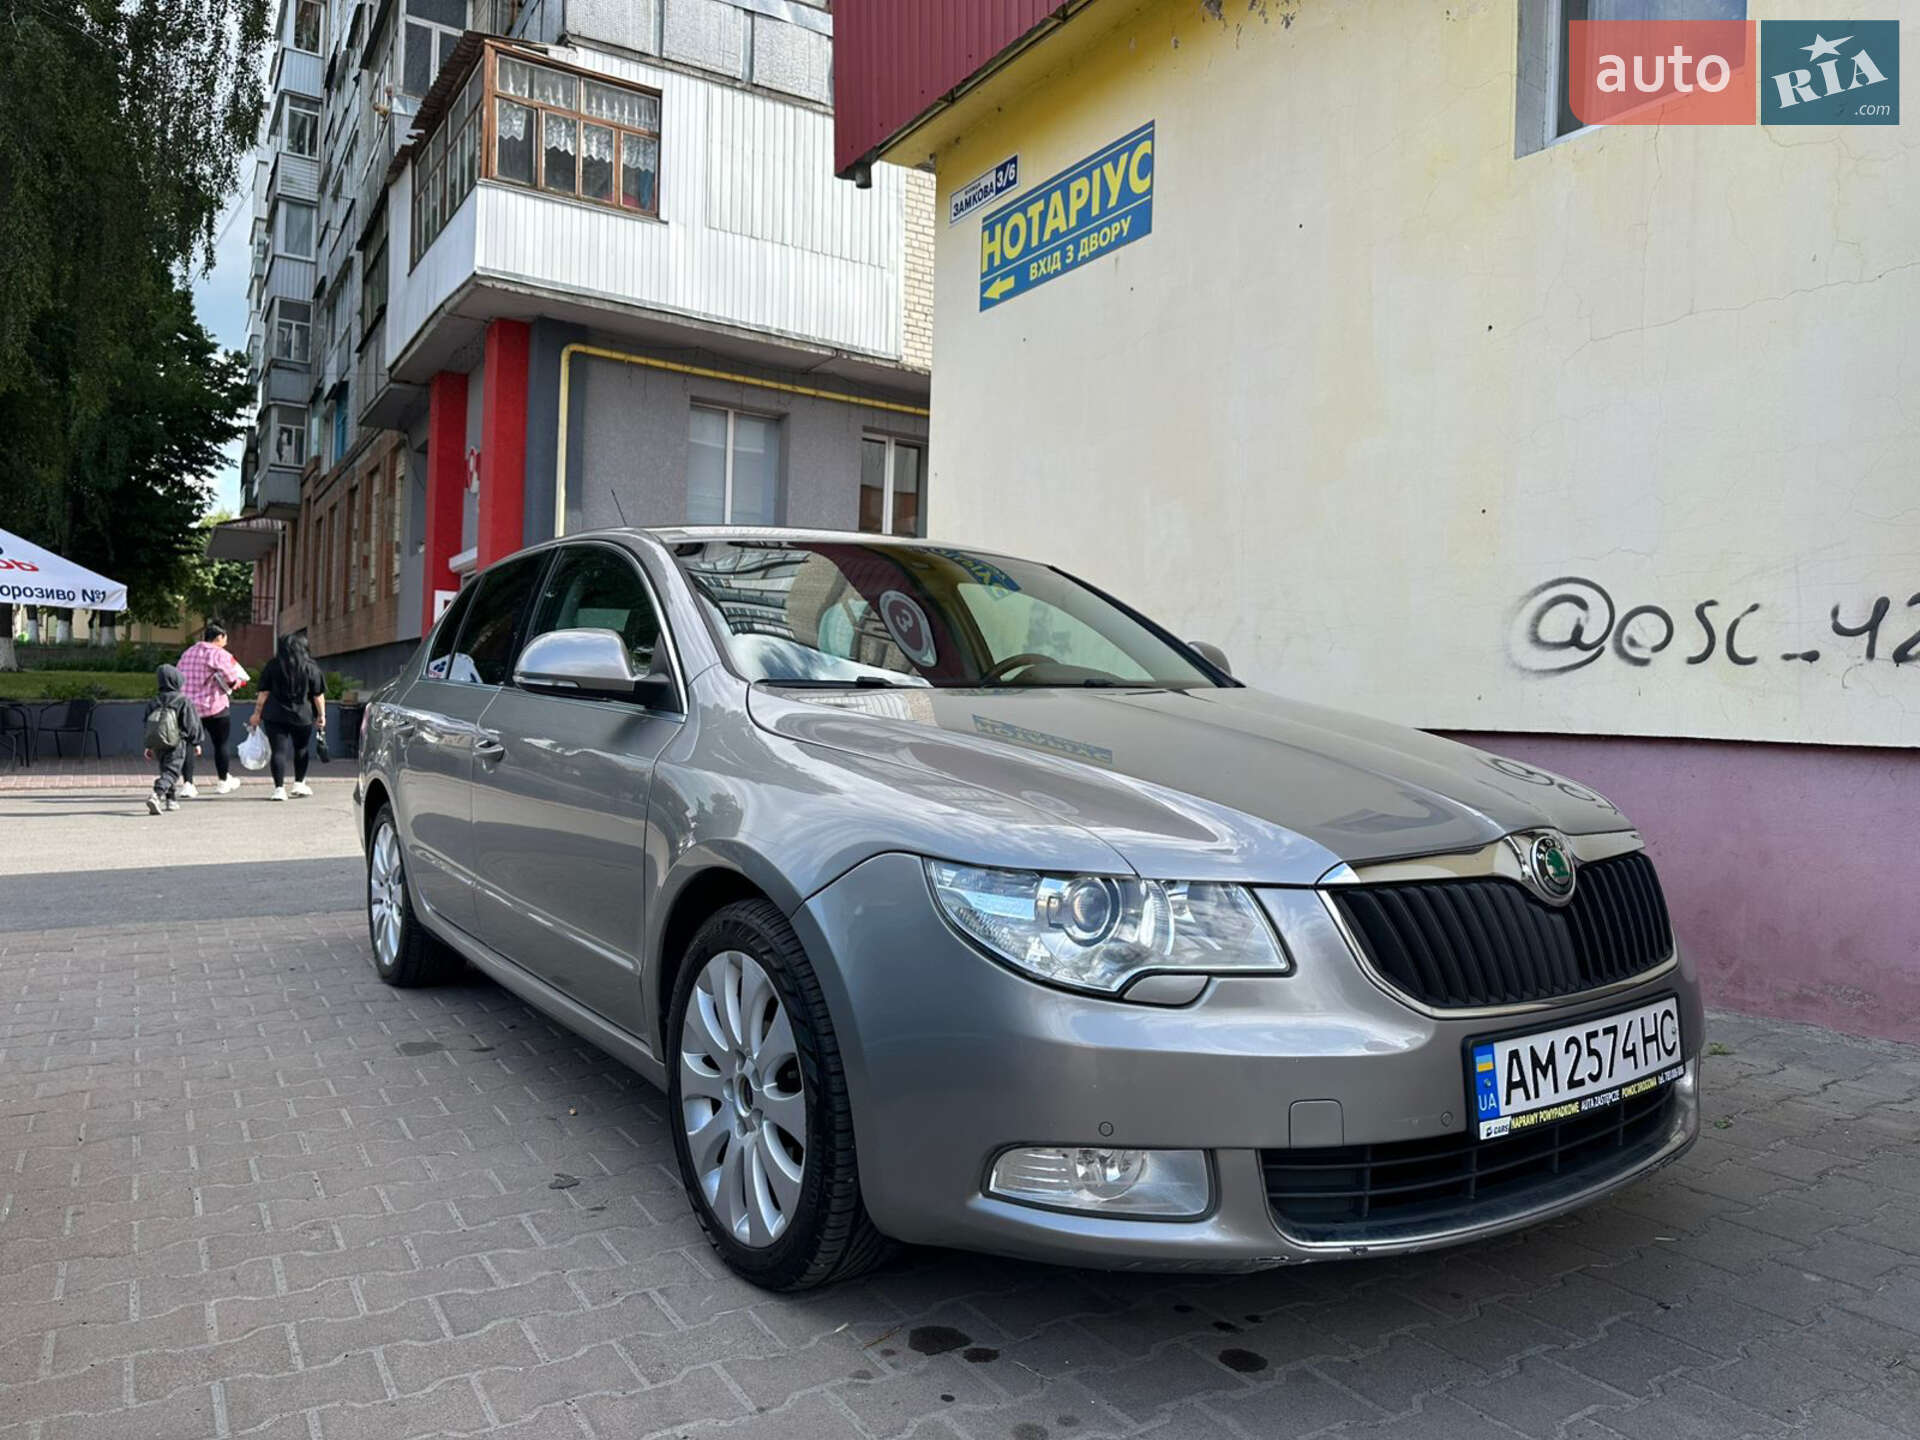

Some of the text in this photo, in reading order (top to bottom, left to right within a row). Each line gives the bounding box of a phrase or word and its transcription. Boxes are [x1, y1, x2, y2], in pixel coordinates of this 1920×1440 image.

[953, 163, 1016, 217] ЗАМКОВА 3/6
[982, 140, 1152, 273] НОТАРІУС
[1029, 252, 1061, 280] ВХІД
[1078, 216, 1132, 259] ДВОРУ
[1478, 1093, 1497, 1111] UA
